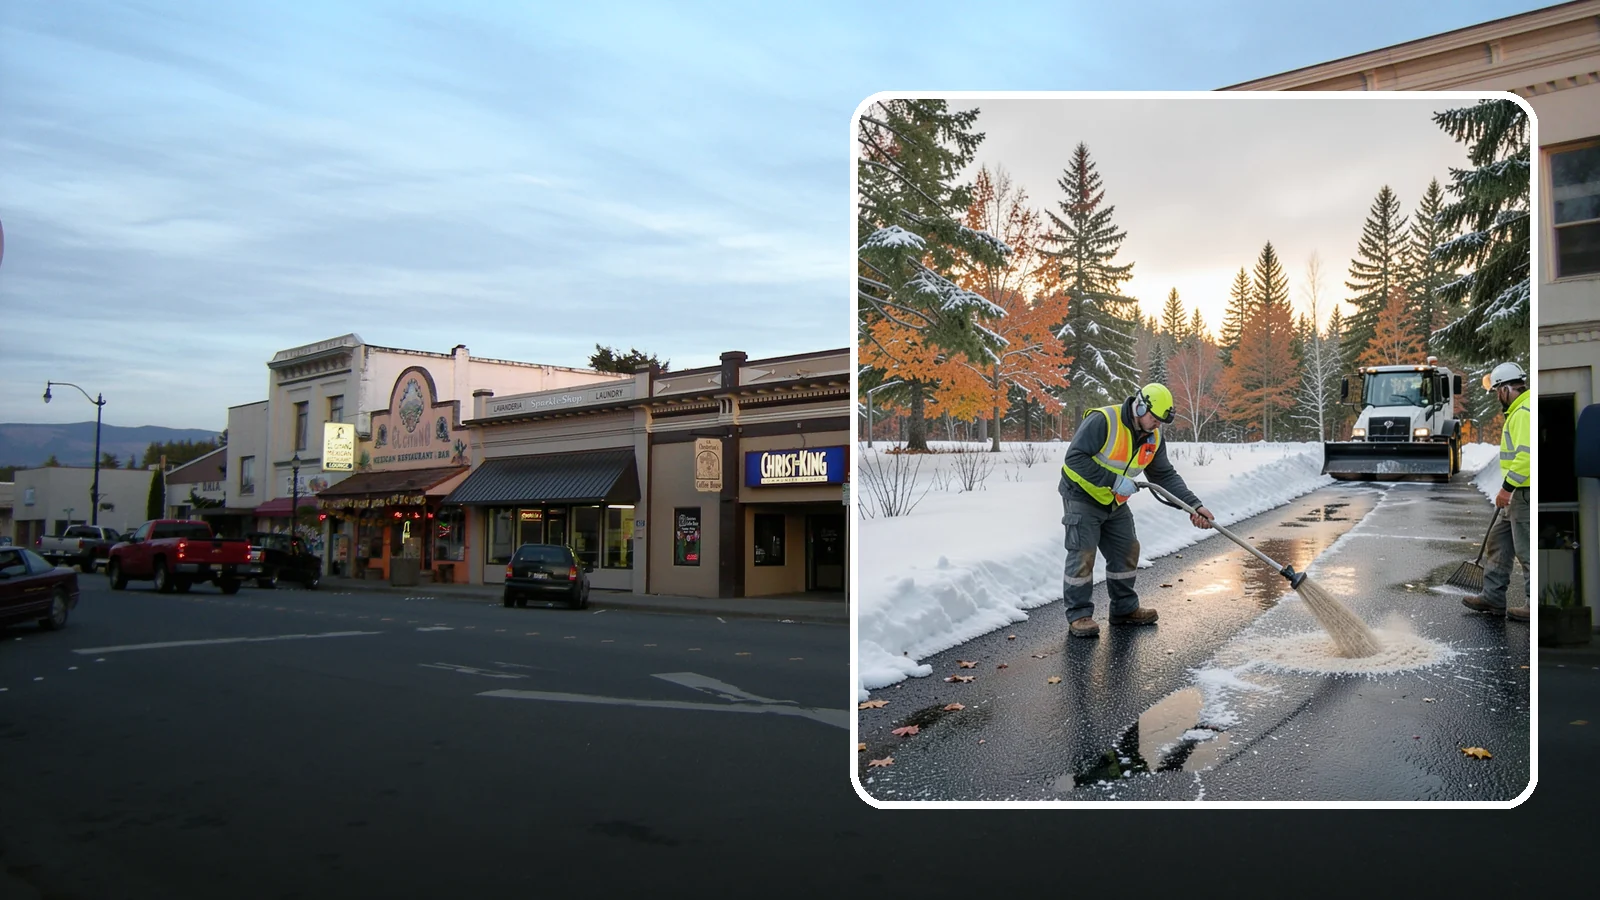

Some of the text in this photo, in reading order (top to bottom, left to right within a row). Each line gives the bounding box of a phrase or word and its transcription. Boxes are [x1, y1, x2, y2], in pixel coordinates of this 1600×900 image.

[531, 394, 582, 409] Sparkle Shop
[596, 389, 624, 400] LAUNDRY
[494, 402, 522, 412] LAVANDERIA
[374, 455, 396, 464] MEXICAN
[397, 451, 433, 462] RESTAURANT
[438, 450, 450, 459] BAR
[761, 450, 827, 478] CHRIST KING
